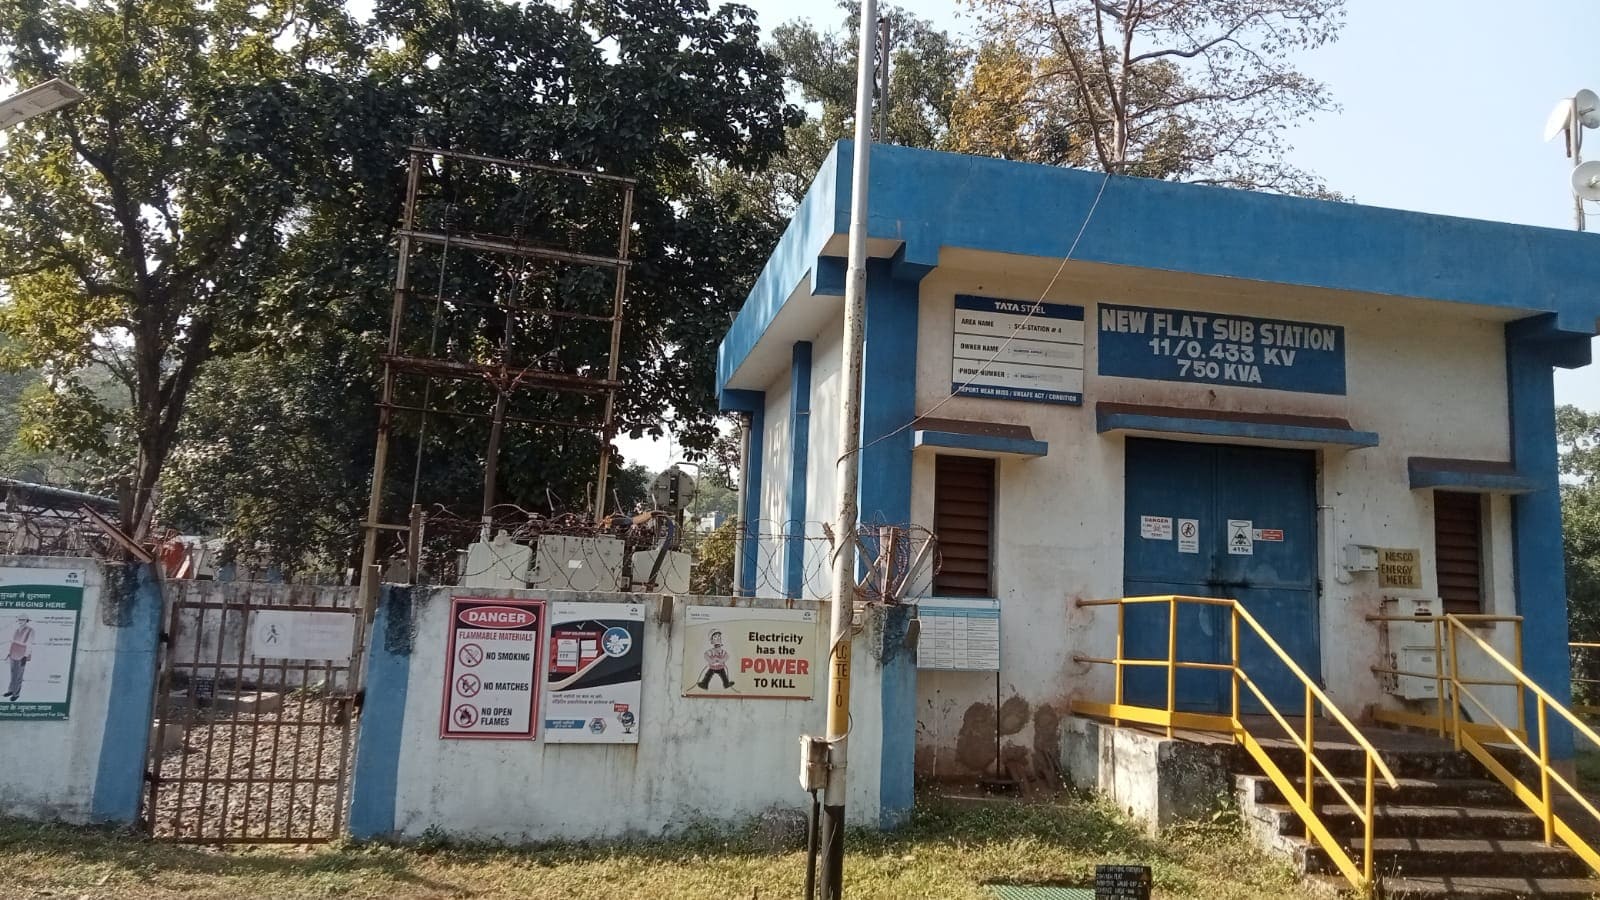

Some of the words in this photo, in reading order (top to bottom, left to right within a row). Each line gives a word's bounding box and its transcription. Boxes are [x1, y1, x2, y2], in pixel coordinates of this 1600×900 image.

[994, 301, 1019, 312] TATA
[1021, 304, 1046, 314] STEEL
[961, 318, 976, 326] AREA
[977, 319, 994, 327] NAME
[1101, 308, 1148, 334] NEW
[1153, 313, 1208, 339] FLAT
[1212, 318, 1255, 343] SUB
[1260, 323, 1335, 352] STATION
[960, 343, 981, 351] OWNER
[982, 344, 999, 352] NAME
[1149, 337, 1256, 363] 11/0.433
[1264, 347, 1297, 367] KV
[959, 367, 978, 376] PHONE
[980, 369, 1005, 378] NUMBER
[1177, 359, 1219, 379] 750
[1224, 363, 1263, 384] KVA
[980, 387, 994, 395] NEAR
[995, 388, 1009, 396] MISS
[1013, 390, 1033, 398] UNSAFE
[1034, 391, 1044, 399] ACT
[1048, 393, 1077, 401] CONDITION
[1385, 552, 1413, 561] NESCO
[1381, 564, 1413, 576] ENERGY
[1386, 575, 1413, 585] METER
[468, 611, 526, 624] DANGER
[459, 631, 496, 641] FLAMMABLE
[498, 632, 533, 641] MATERIALS
[748, 631, 804, 645] Electricity
[756, 644, 776, 655] has
[778, 645, 796, 655] the
[486, 651, 496, 660] NO
[497, 652, 530, 662] SMOKING
[740, 657, 809, 675] POWER
[835, 663, 848, 677] TE
[483, 682, 493, 691] NO
[495, 682, 529, 692] MATCHES
[753, 678, 768, 688] TO
[771, 678, 796, 689] KILL
[481, 707, 491, 716] NO
[493, 708, 512, 716] OPEN
[480, 717, 510, 726] FLAMES
